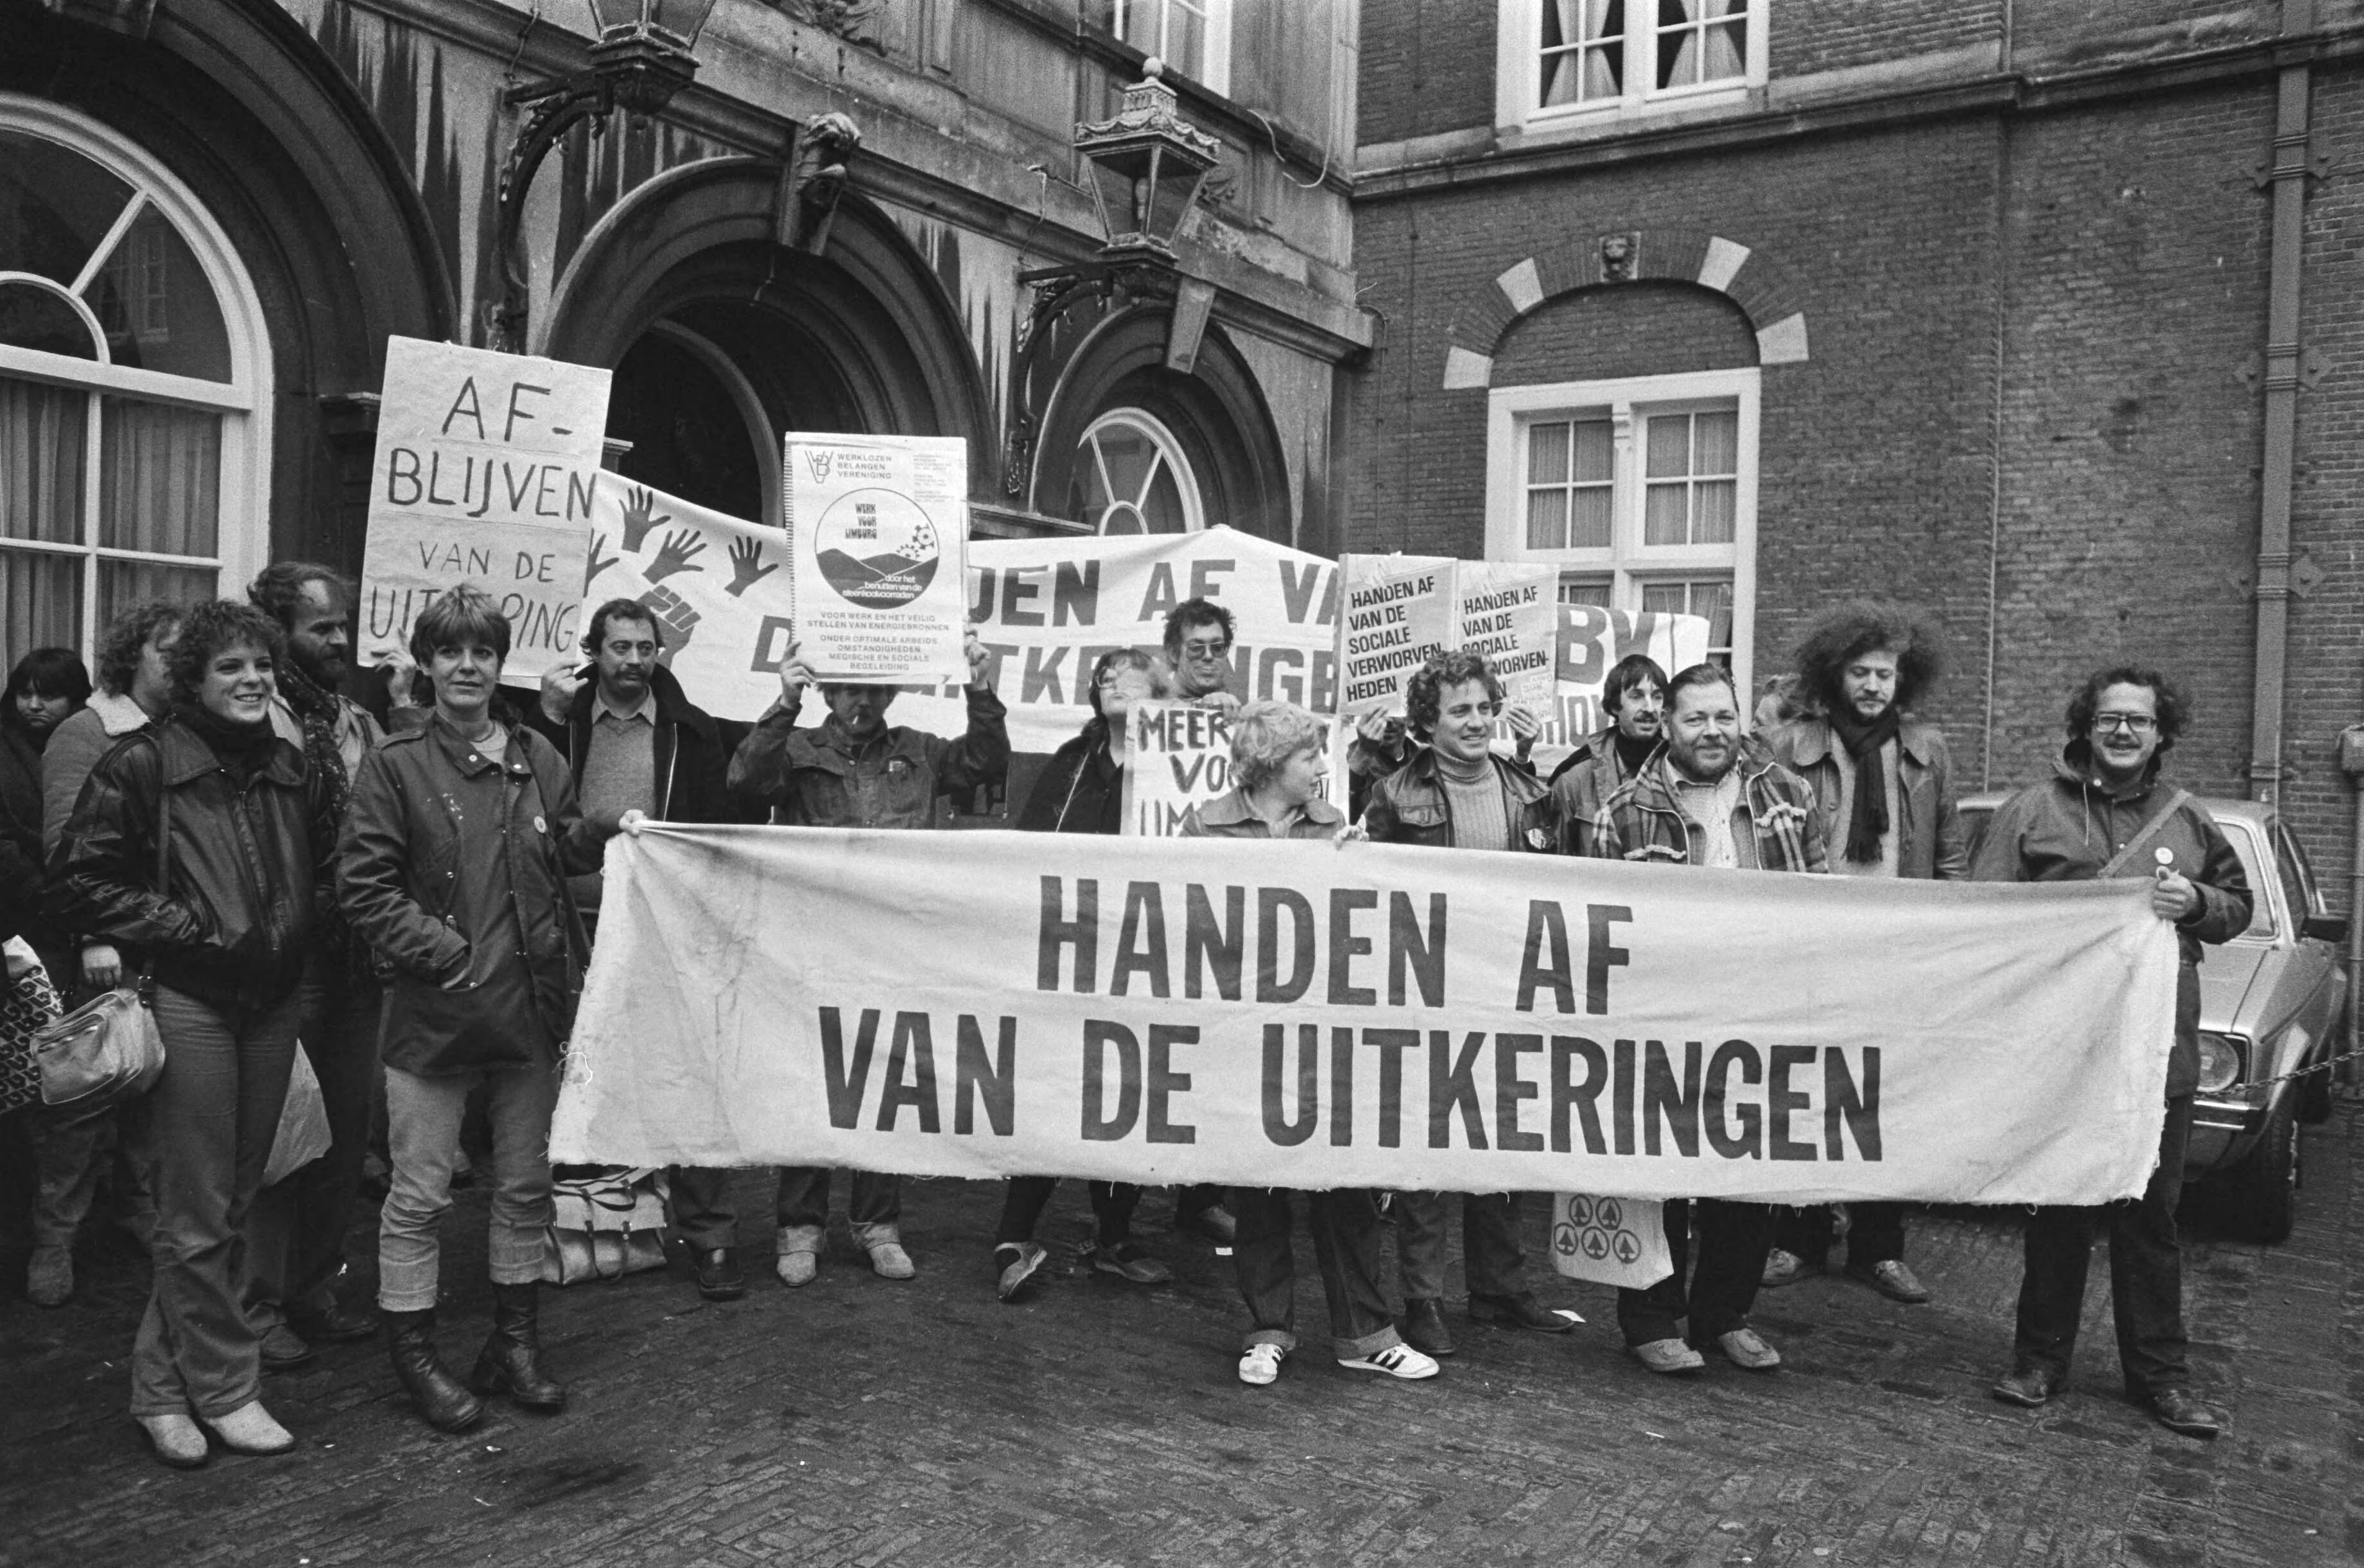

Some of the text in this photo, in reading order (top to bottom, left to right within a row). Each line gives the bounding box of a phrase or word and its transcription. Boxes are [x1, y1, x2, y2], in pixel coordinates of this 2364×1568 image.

[388, 448, 597, 521] BLIJVEN
[837, 471, 891, 479] VERENIGING
[856, 503, 876, 514] WERK
[858, 516, 876, 527] VOOR
[845, 528, 877, 539] LIMBURG
[420, 541, 555, 582] VAN DE
[1137, 559, 1235, 622] AF
[1350, 576, 1435, 609] HANDEN AF
[1464, 586, 1538, 615] HANDEN AF
[1348, 605, 1406, 631] VAN DE
[1463, 613, 1513, 638] VAN DE
[837, 645, 921, 653] OMSTANDIGHEDEN
[1348, 627, 1411, 655] SOCIALE
[1346, 675, 1397, 702] HEDEN
[1138, 705, 1231, 752] MEER
[1038, 875, 1633, 1015] HANDEN AF
[819, 1007, 1882, 1162] VAN DE UITKERINGEN
